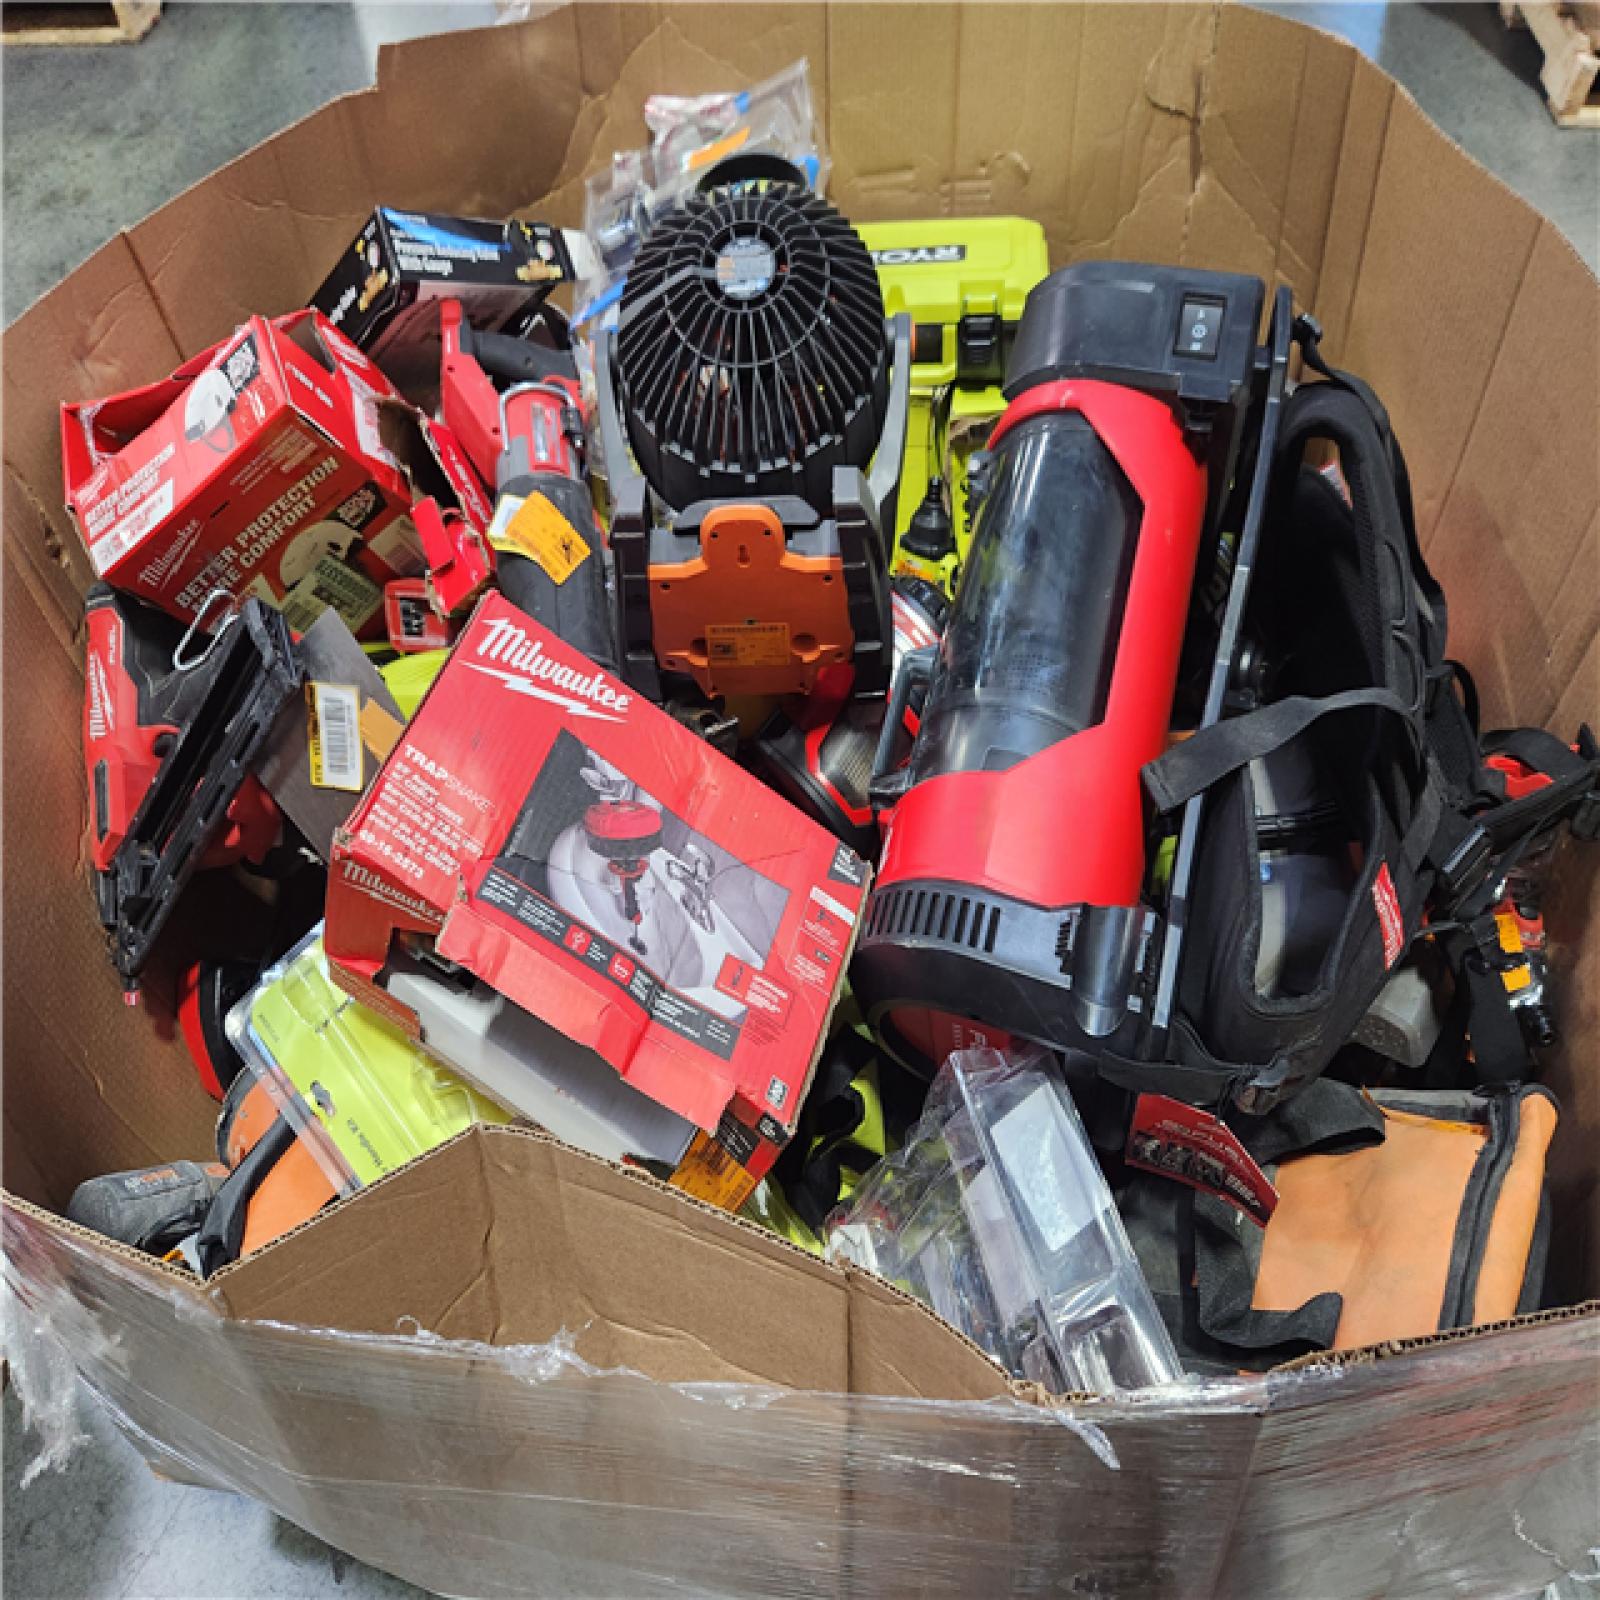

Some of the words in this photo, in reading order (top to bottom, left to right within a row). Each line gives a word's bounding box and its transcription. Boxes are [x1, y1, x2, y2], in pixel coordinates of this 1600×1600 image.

[174, 545, 238, 608] BETTER
[236, 455, 339, 548] PROTECTION
[239, 493, 316, 568] COMFORT
[88, 652, 107, 742] Milwaukee
[476, 616, 632, 712] Milwaukee
[405, 744, 490, 813] TRAPSNAKE
[344, 861, 444, 921] Milwaukee
